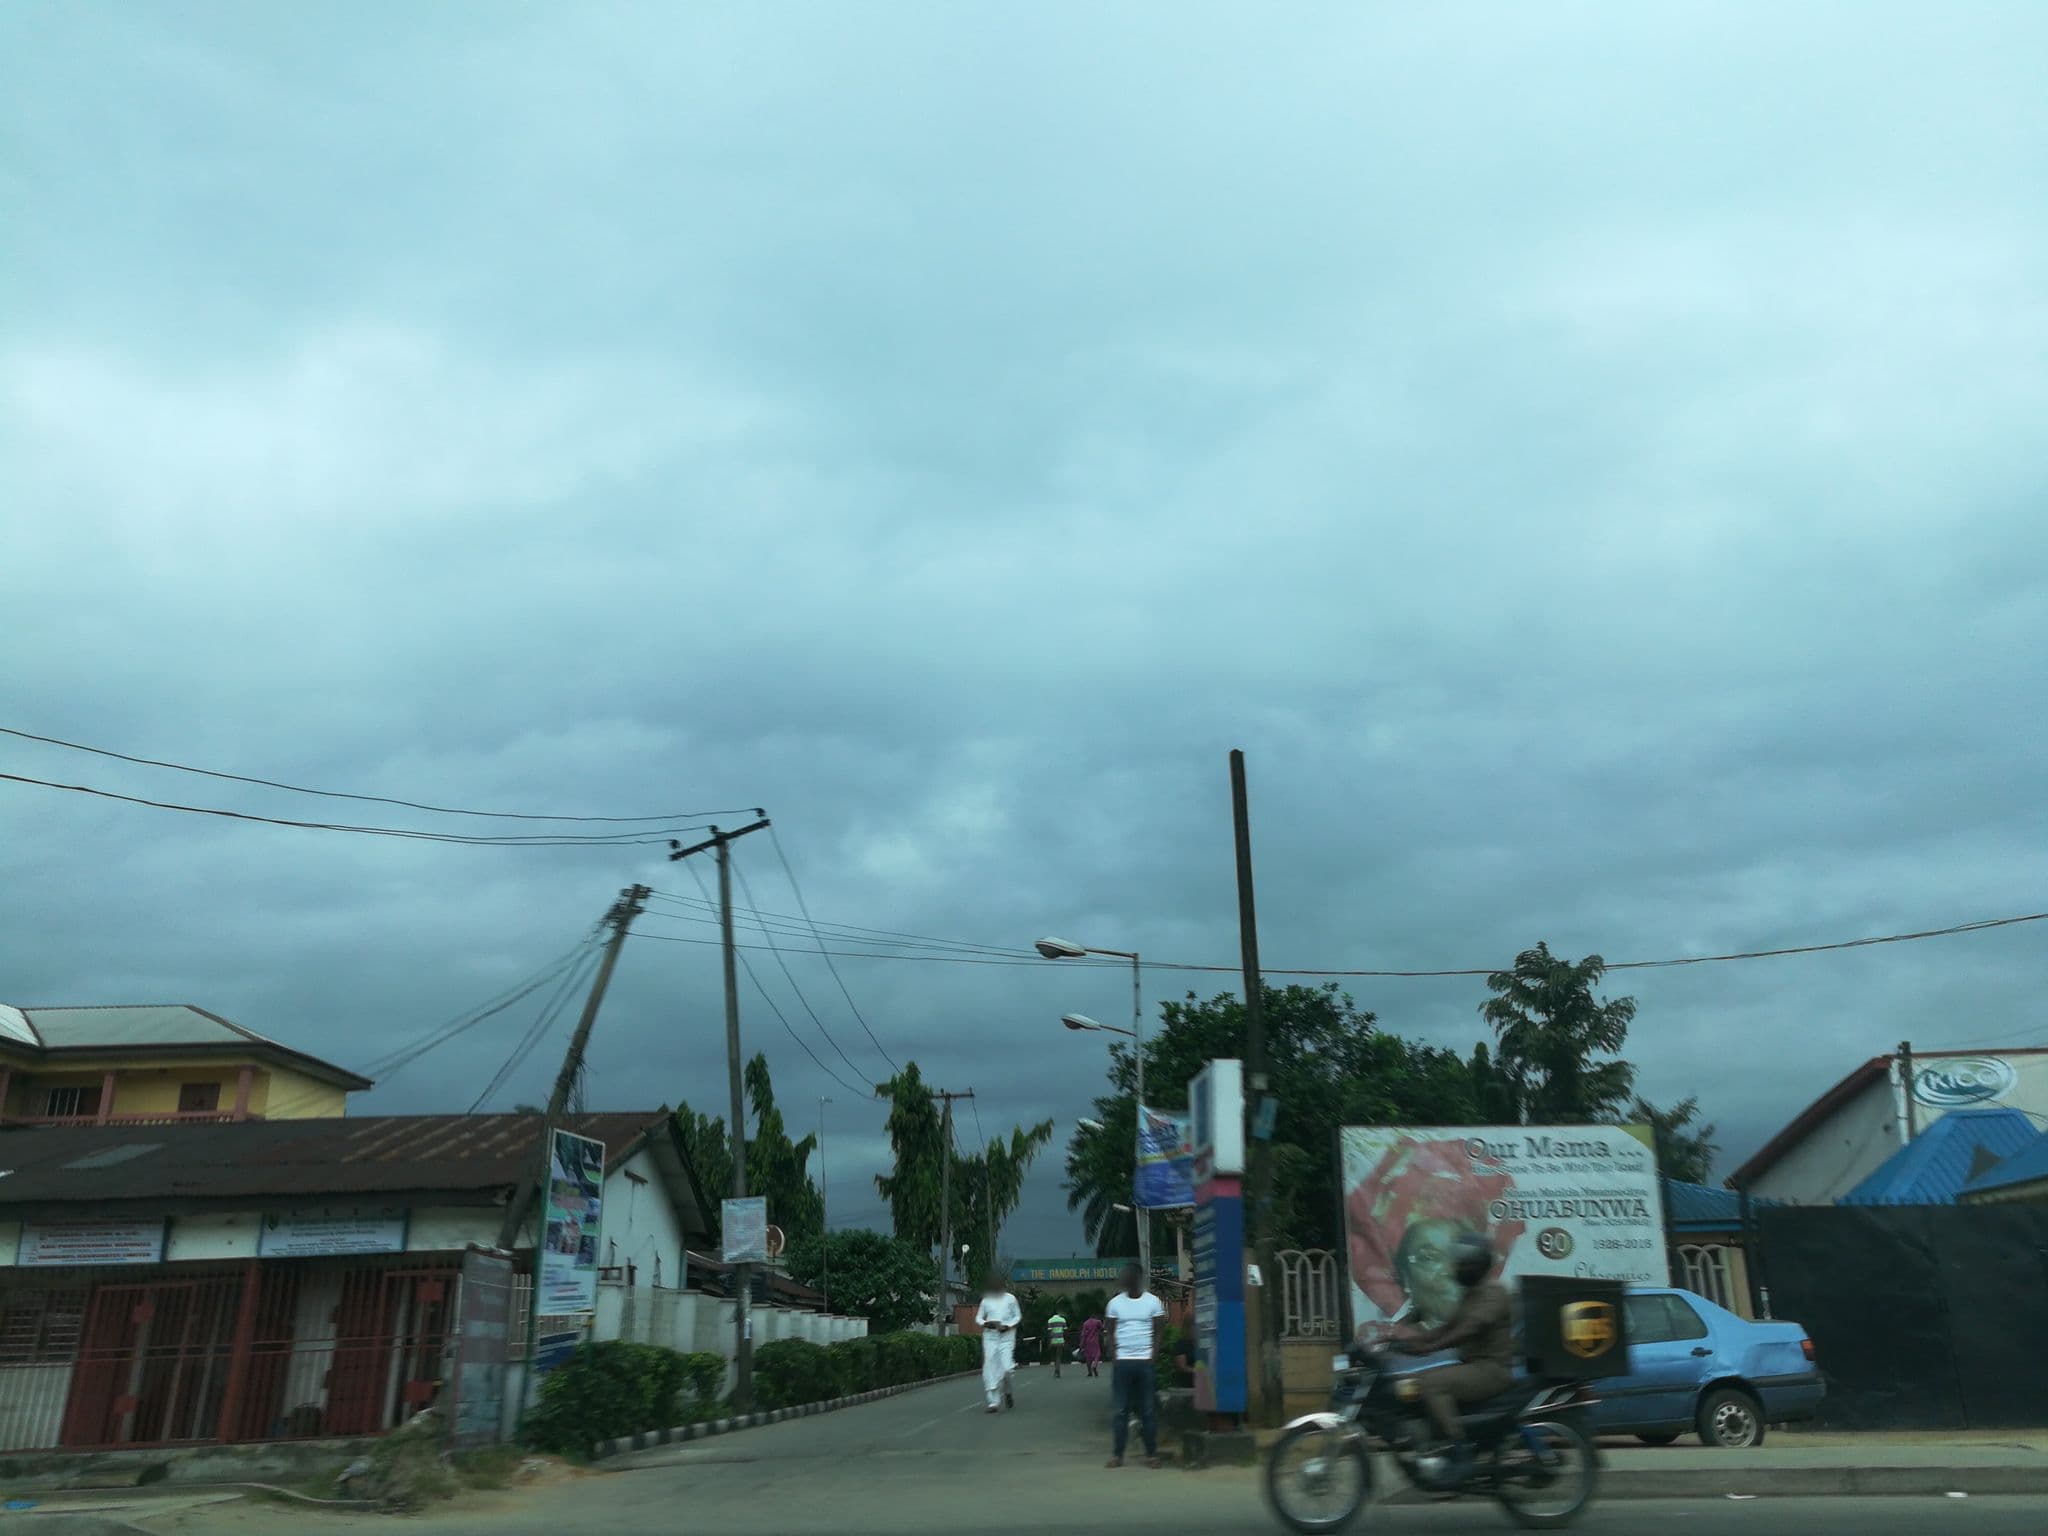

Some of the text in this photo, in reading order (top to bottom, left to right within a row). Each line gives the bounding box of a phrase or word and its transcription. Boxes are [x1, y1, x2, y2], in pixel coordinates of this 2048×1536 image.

[1465, 1137, 1519, 1159] Our
[1525, 1136, 1612, 1158] Mama
[1489, 1199, 1650, 1219] OHUABUNWA
[1541, 1232, 1567, 1252] 90
[1031, 1267, 1118, 1280] THE RANDOLPH HOTEL
